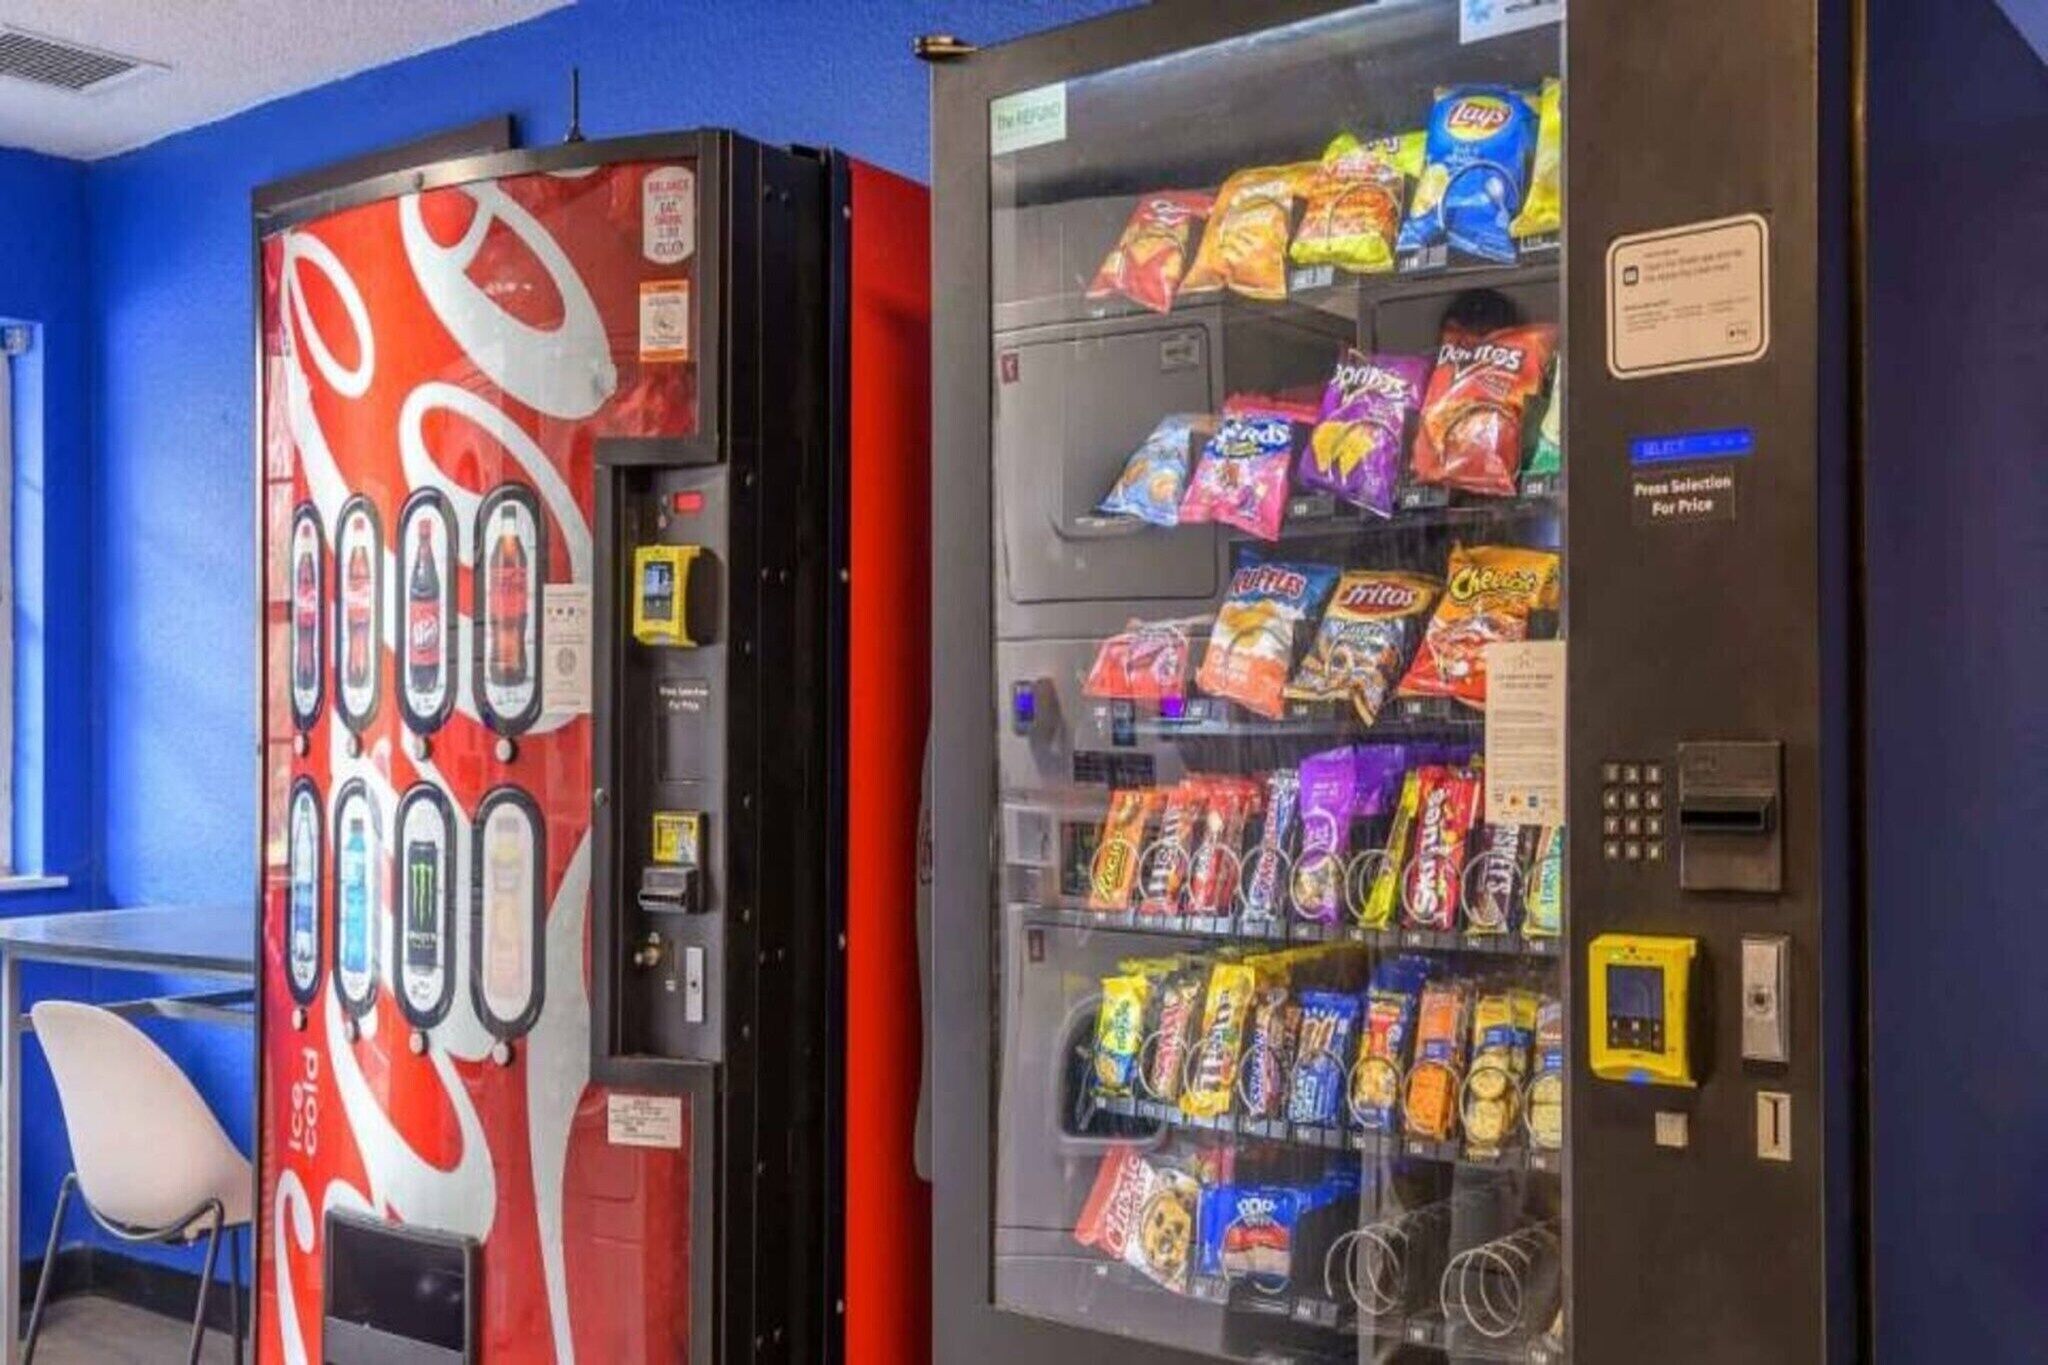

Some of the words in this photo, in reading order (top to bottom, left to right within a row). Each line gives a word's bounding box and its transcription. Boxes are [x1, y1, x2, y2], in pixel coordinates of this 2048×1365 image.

[1671, 473, 1731, 494] Selection
[1652, 501, 1675, 516] For
[1678, 497, 1714, 515] Price
[288, 1081, 304, 1152] Ice
